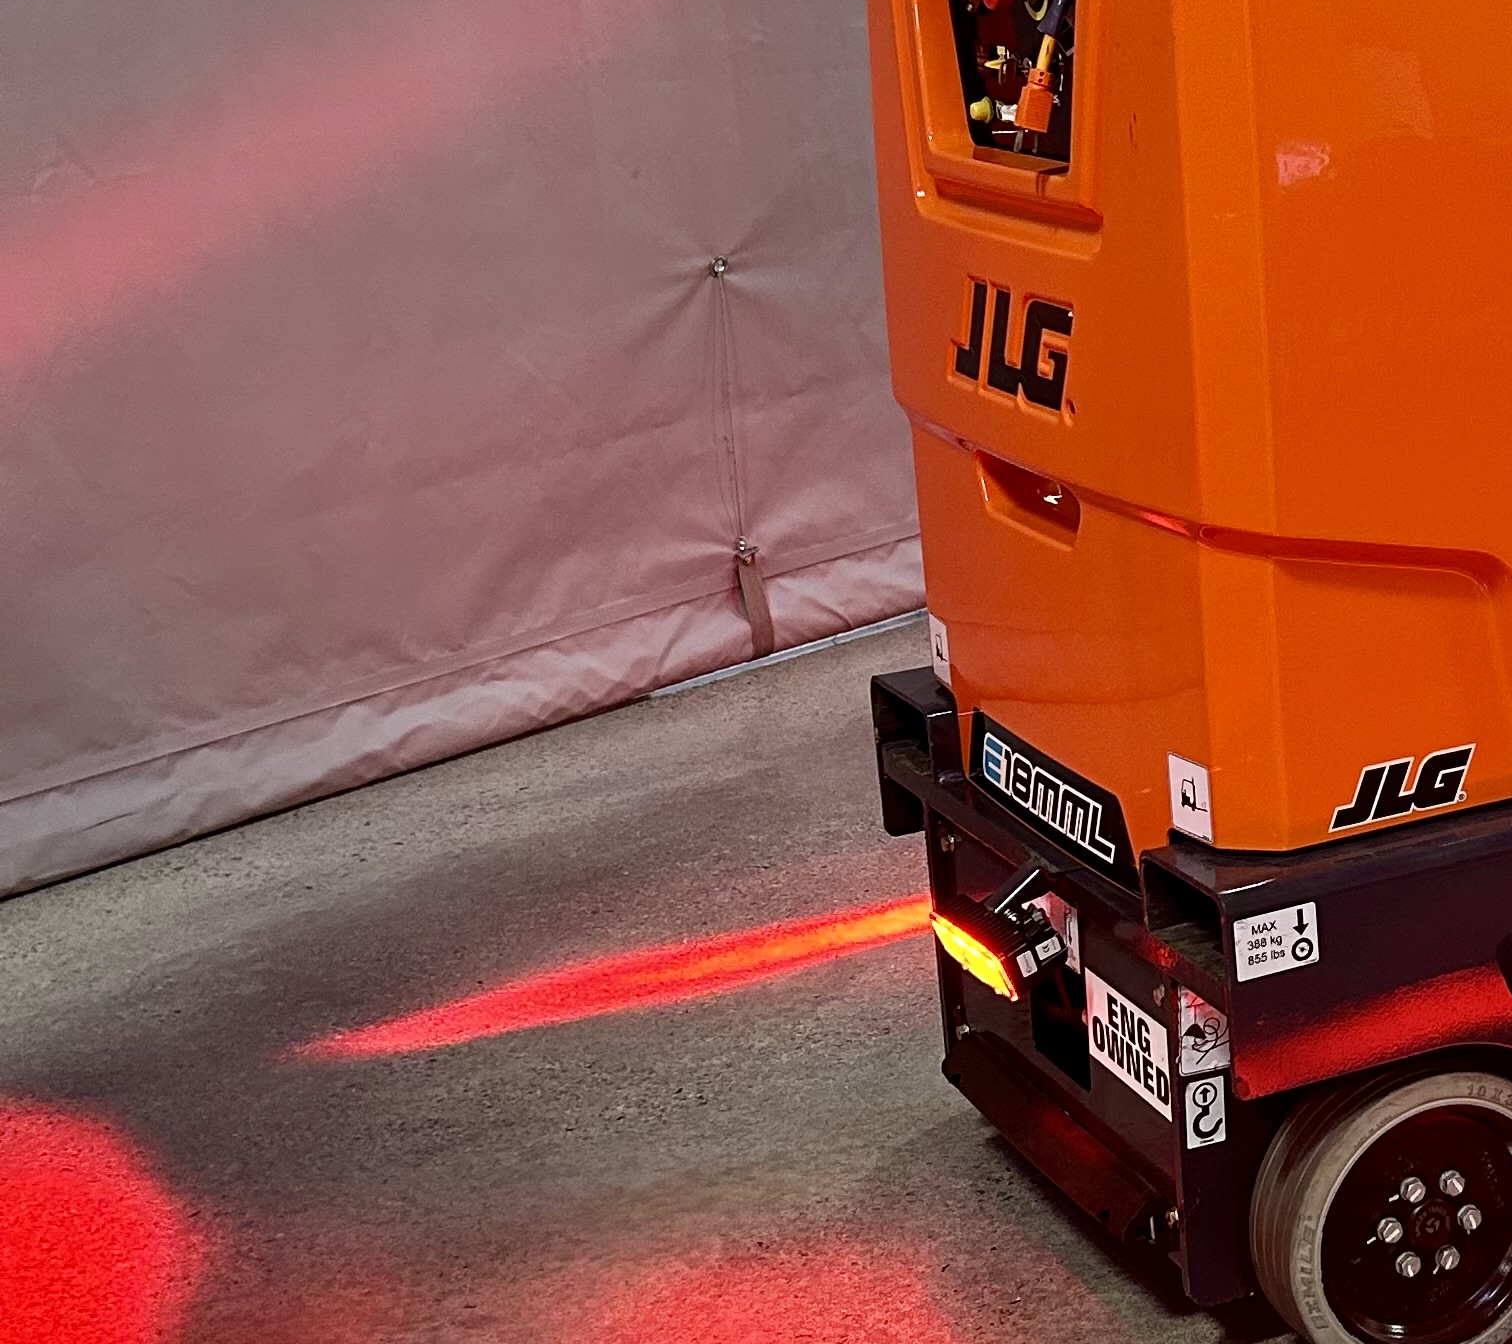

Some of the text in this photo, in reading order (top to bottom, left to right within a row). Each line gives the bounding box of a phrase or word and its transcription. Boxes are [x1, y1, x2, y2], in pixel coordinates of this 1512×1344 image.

[952, 278, 1075, 413] JLG
[982, 731, 1116, 864] E18MML
[1328, 743, 1477, 834] JLG
[1247, 936, 1283, 951] 388 kg
[1247, 949, 1286, 966] 855 lbs
[1251, 919, 1278, 936] MAX
[1106, 992, 1152, 1058] ENG
[1092, 1015, 1170, 1107] OWNED
[1466, 1083, 1487, 1097] 10
